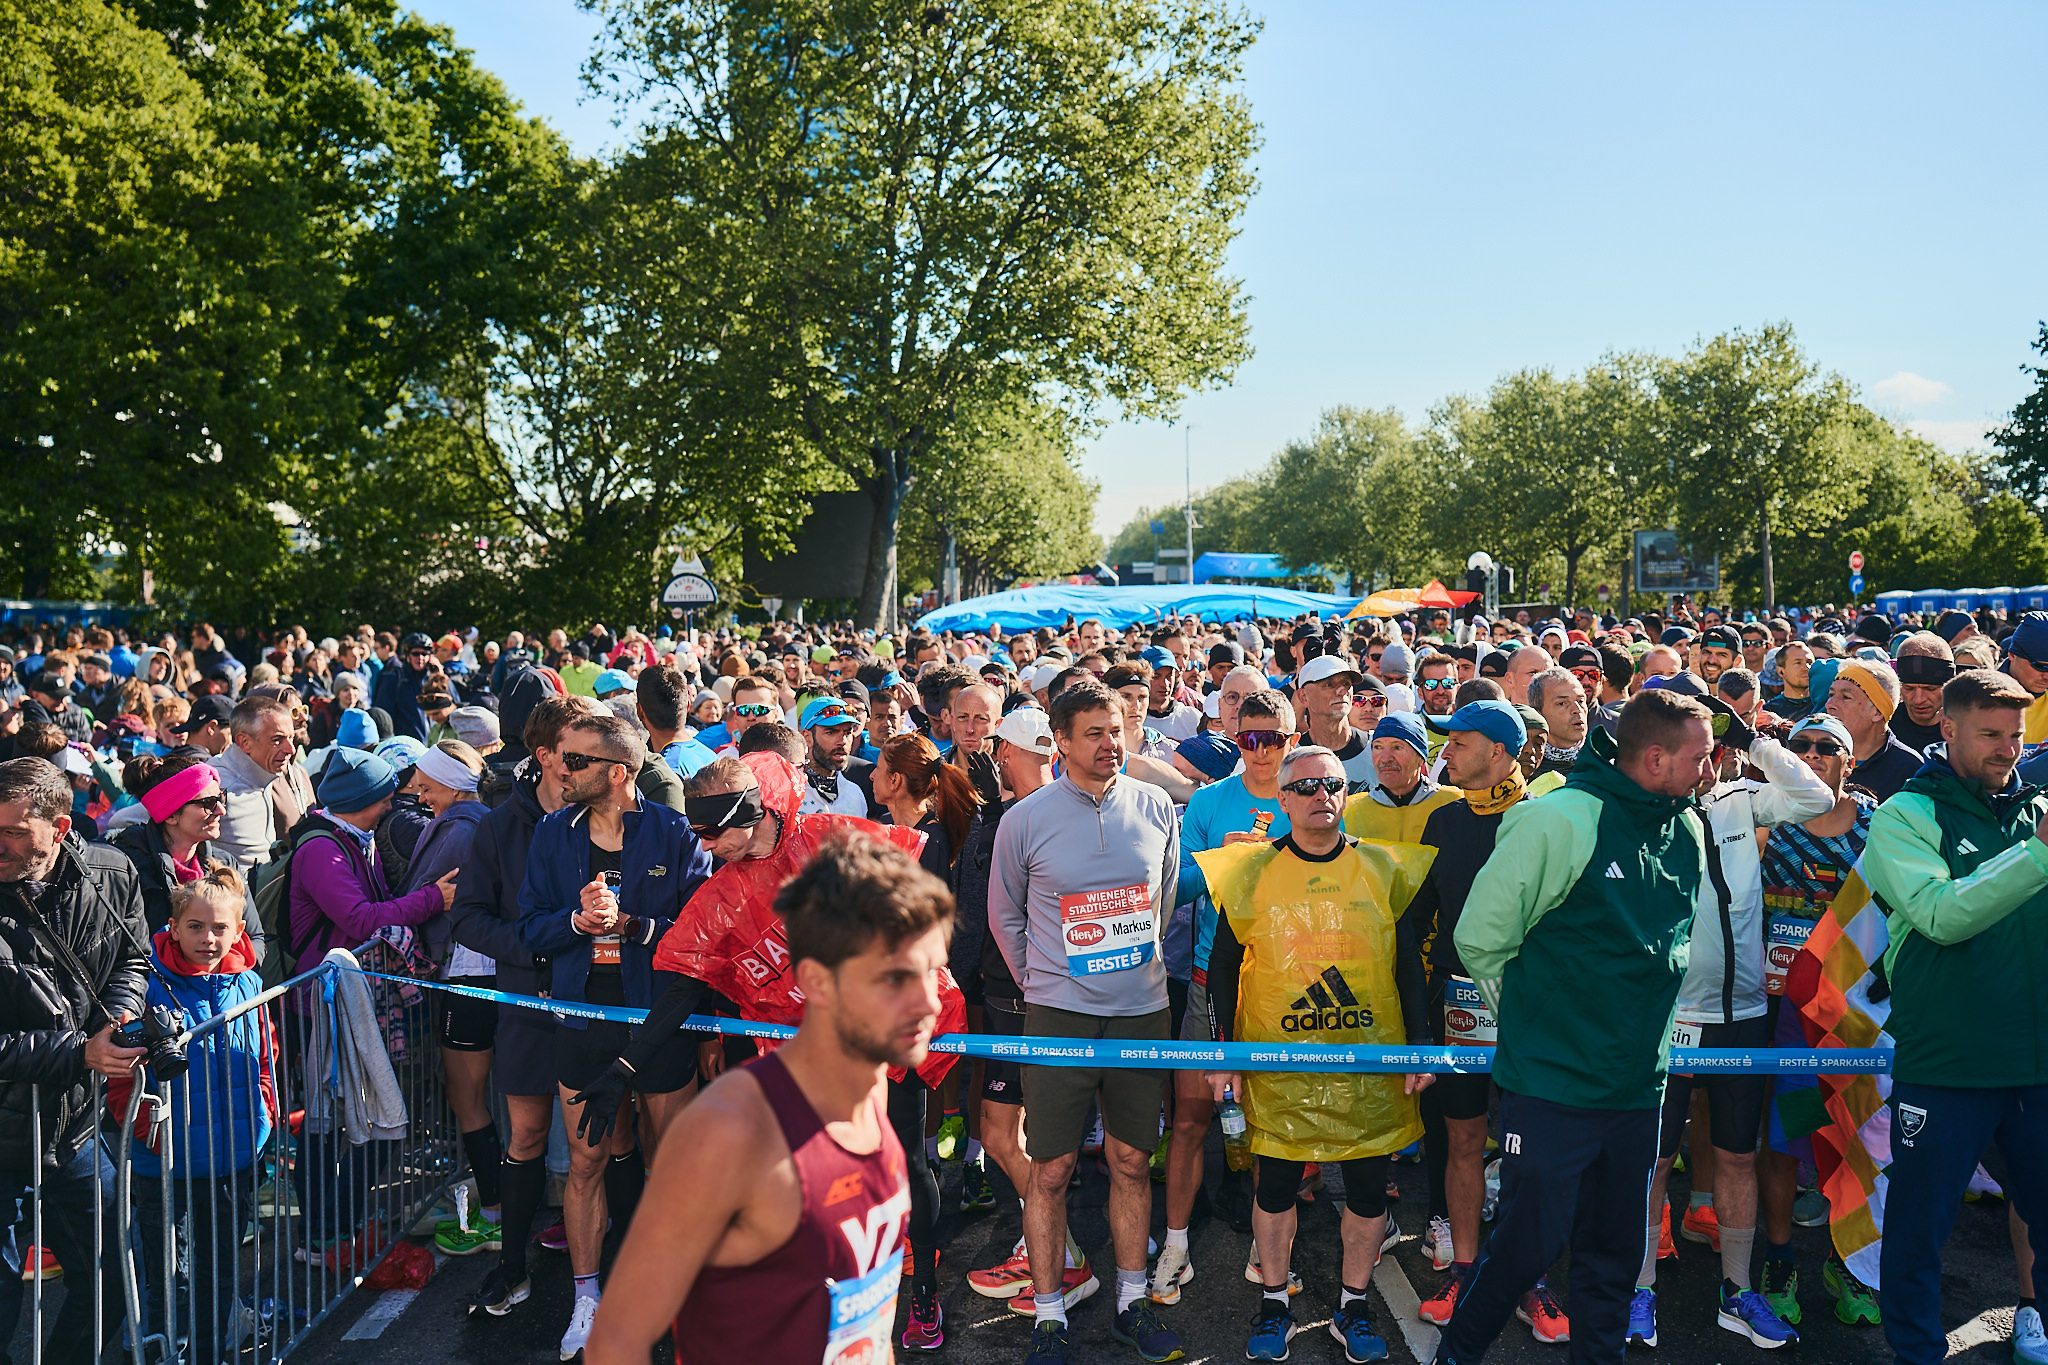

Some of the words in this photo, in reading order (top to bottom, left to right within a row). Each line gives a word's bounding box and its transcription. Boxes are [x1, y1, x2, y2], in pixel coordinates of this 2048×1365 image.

[1086, 888, 1127, 903] WIENER
[1068, 899, 1128, 916] STÄDTISCHE
[1070, 927, 1103, 941] Hervis
[1112, 920, 1152, 936] Markus
[741, 928, 790, 979] BA
[1087, 954, 1129, 973] ERSTE
[1456, 988, 1481, 1001] ERS
[1281, 1007, 1374, 1032] adidas
[1448, 1013, 1475, 1027] Hervis
[992, 1043, 1019, 1055] ERSTE
[1031, 1046, 1084, 1057] SPARKASSE
[1120, 1049, 1148, 1059] ERSTE
[1161, 1050, 1214, 1060] SPARKASSE
[1250, 1052, 1279, 1062] ERSTE
[1291, 1053, 1345, 1063] SPARKASSE
[1381, 1055, 1409, 1064] ERSTE
[1687, 1058, 1742, 1067] SPARKASSE
[1779, 1058, 1807, 1067] ERSTE
[1821, 1058, 1876, 1067] SPARKASSE
[1505, 1132, 1521, 1155] TR
[1901, 1137, 1914, 1148] MS
